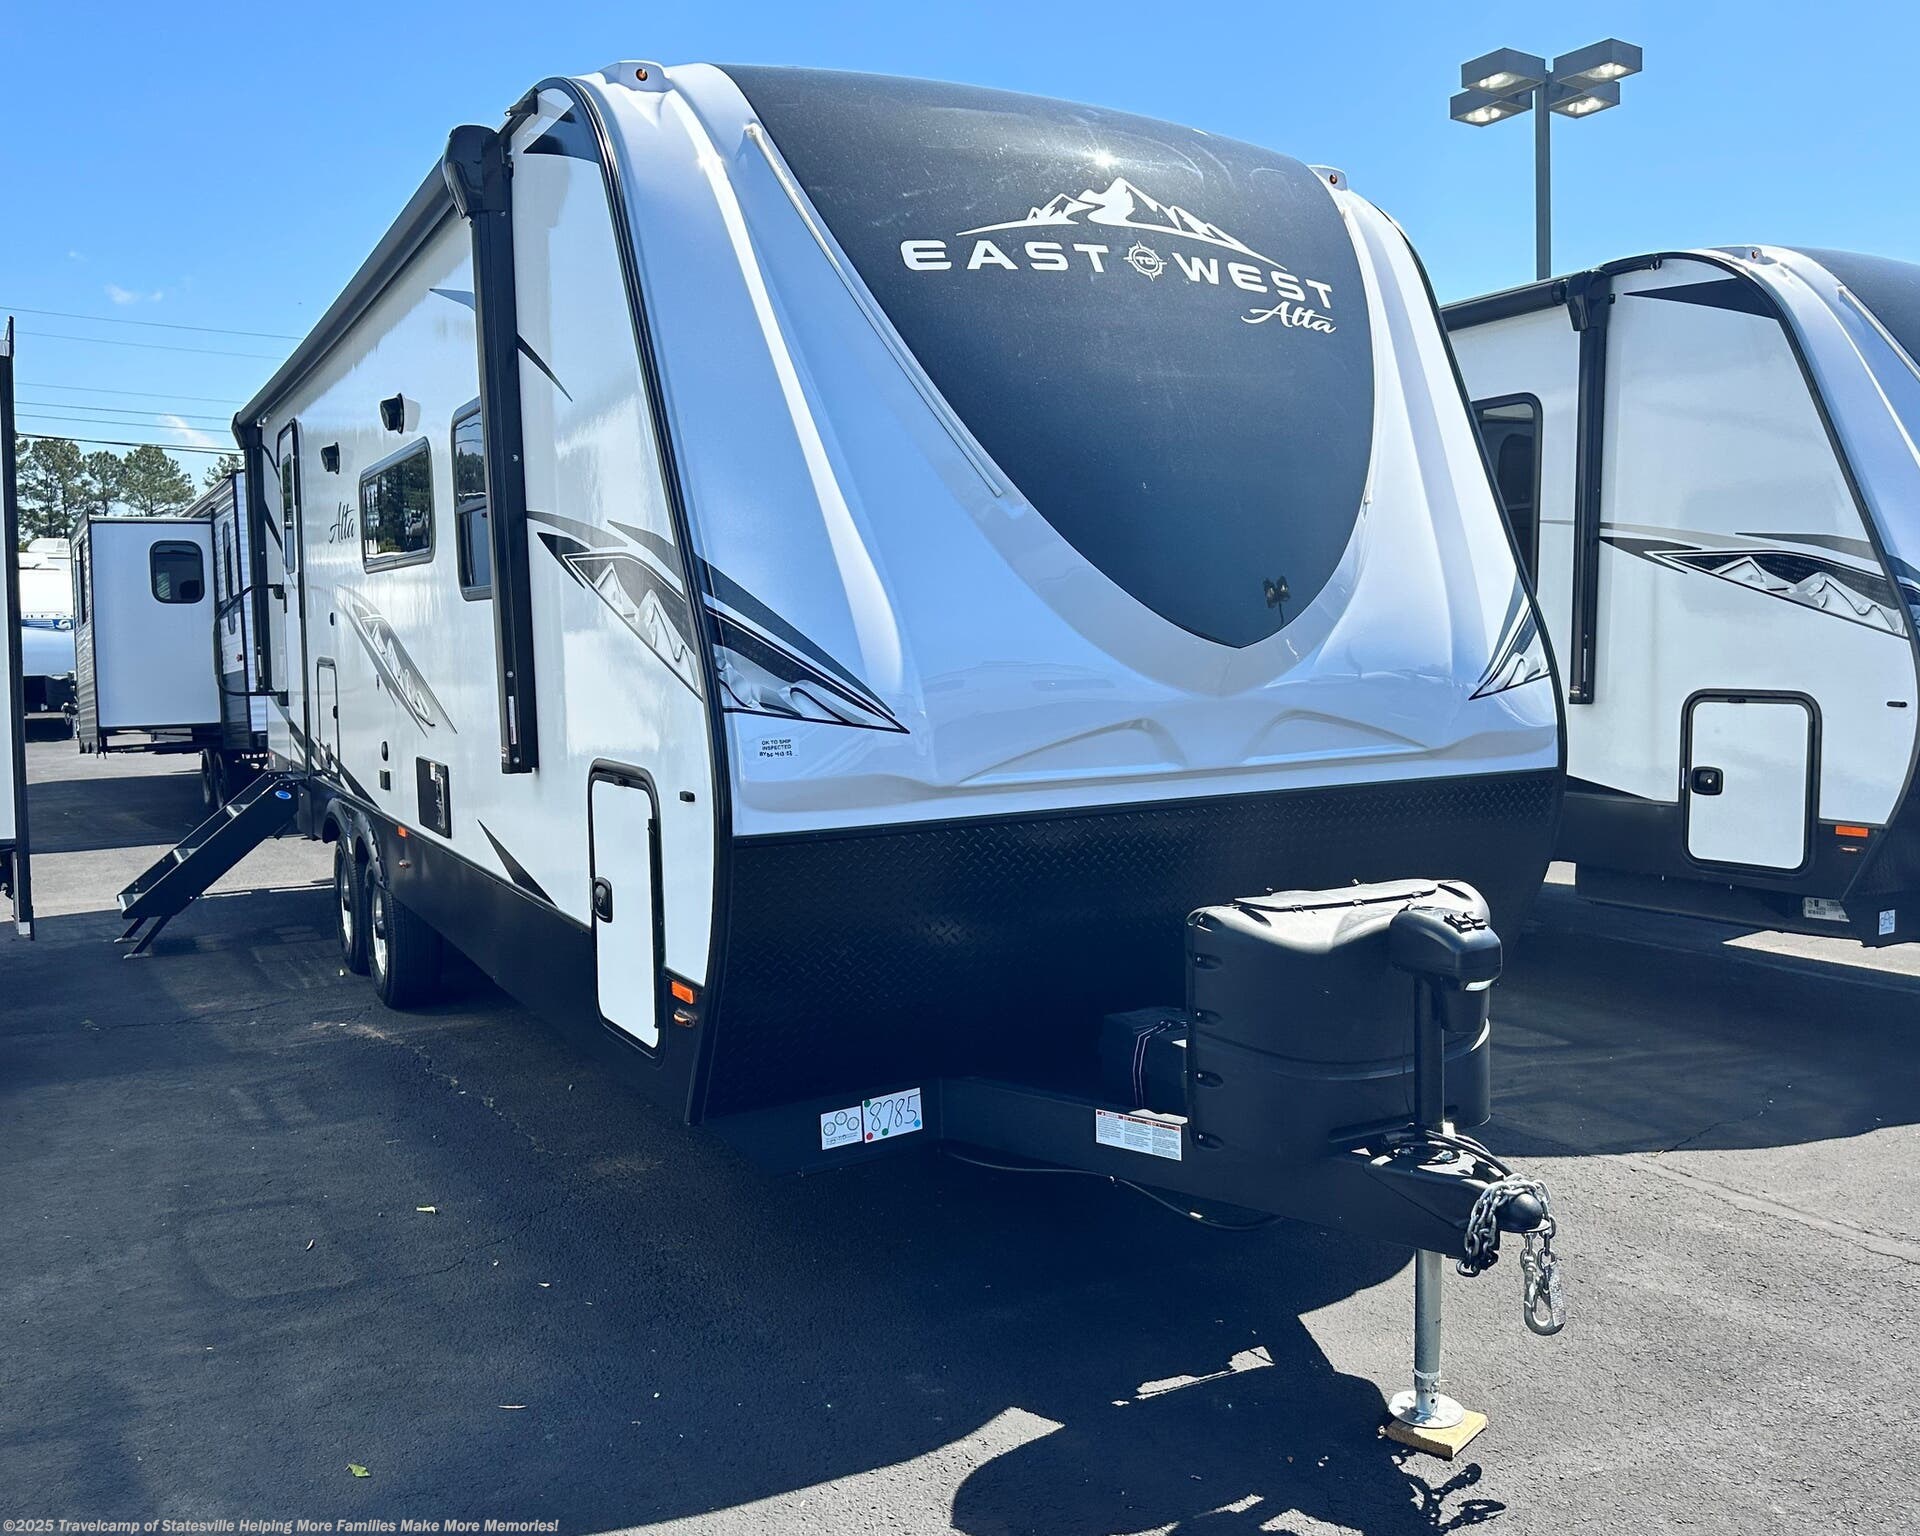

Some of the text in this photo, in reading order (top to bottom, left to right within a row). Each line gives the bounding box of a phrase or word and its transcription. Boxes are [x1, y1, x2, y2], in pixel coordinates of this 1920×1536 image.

[900, 240, 1335, 309] EAST TO WEST
[1240, 301, 1337, 335] Alta
[328, 501, 355, 544] Alta
[869, 1093, 920, 1132] 8785
